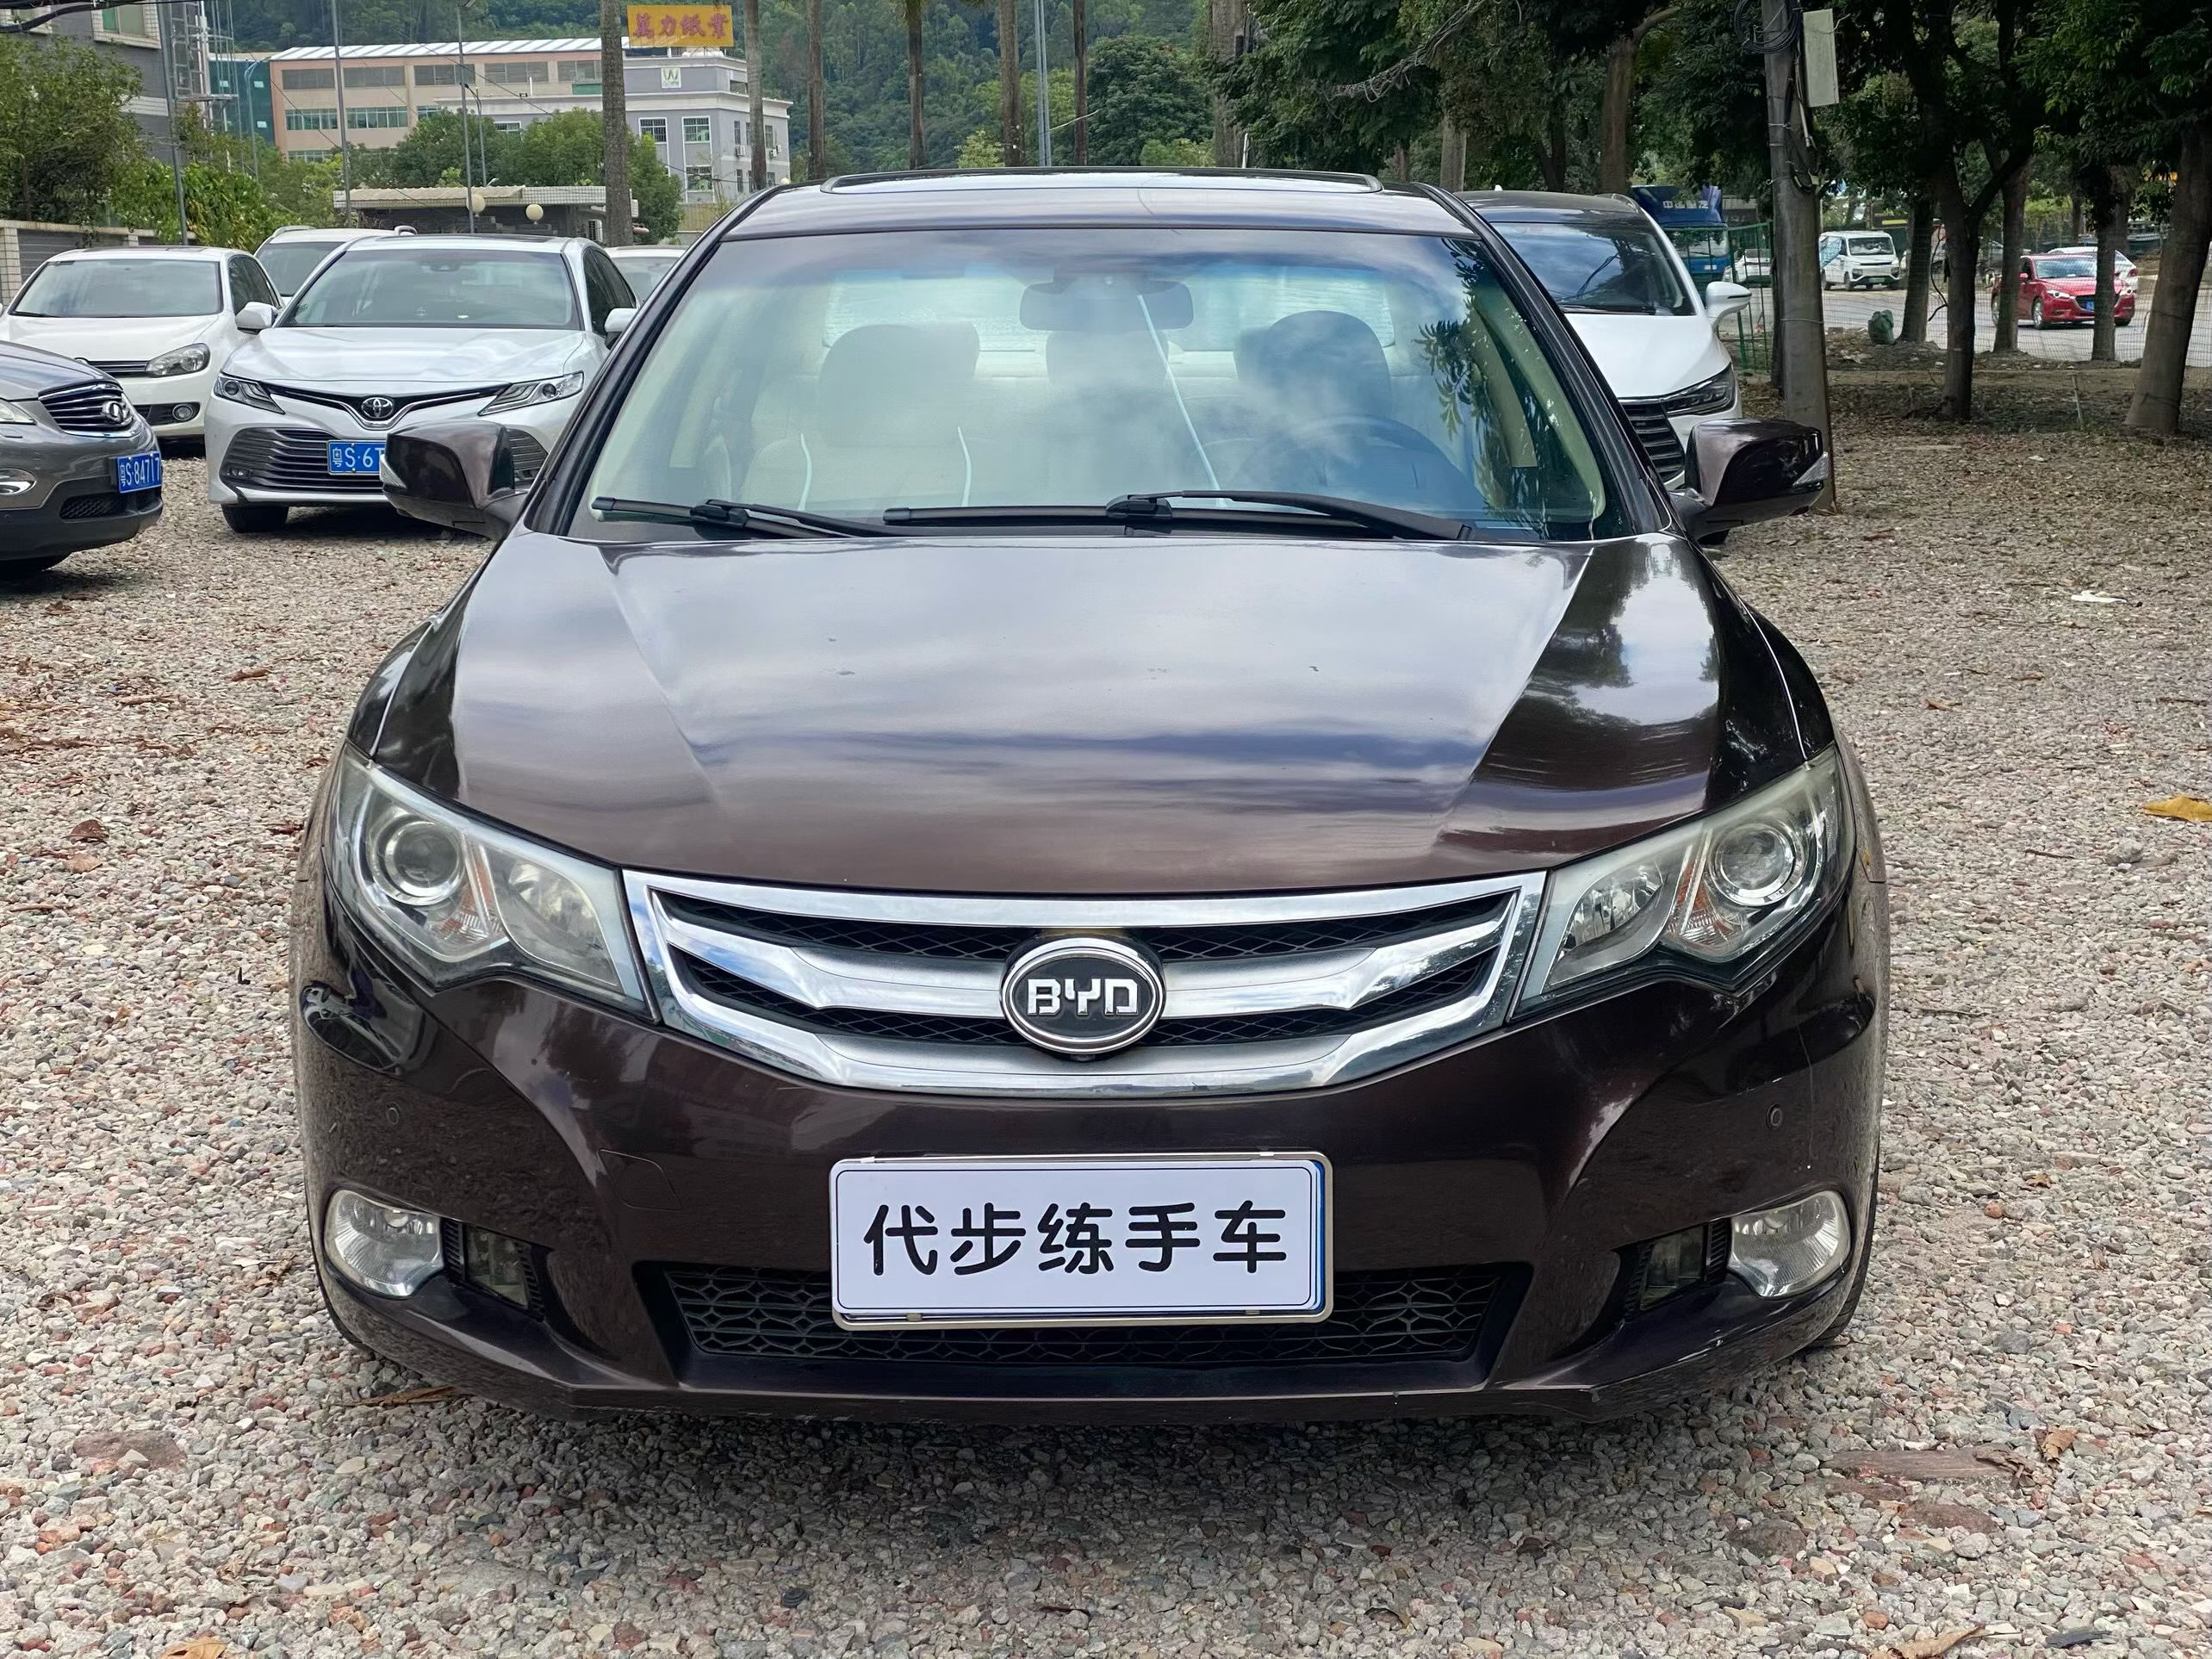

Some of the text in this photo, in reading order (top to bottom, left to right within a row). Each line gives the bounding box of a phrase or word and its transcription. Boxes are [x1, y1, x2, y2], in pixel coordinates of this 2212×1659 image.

[1027, 979, 1139, 1016] BYD
[863, 1200, 1287, 1277] 代步练手车
